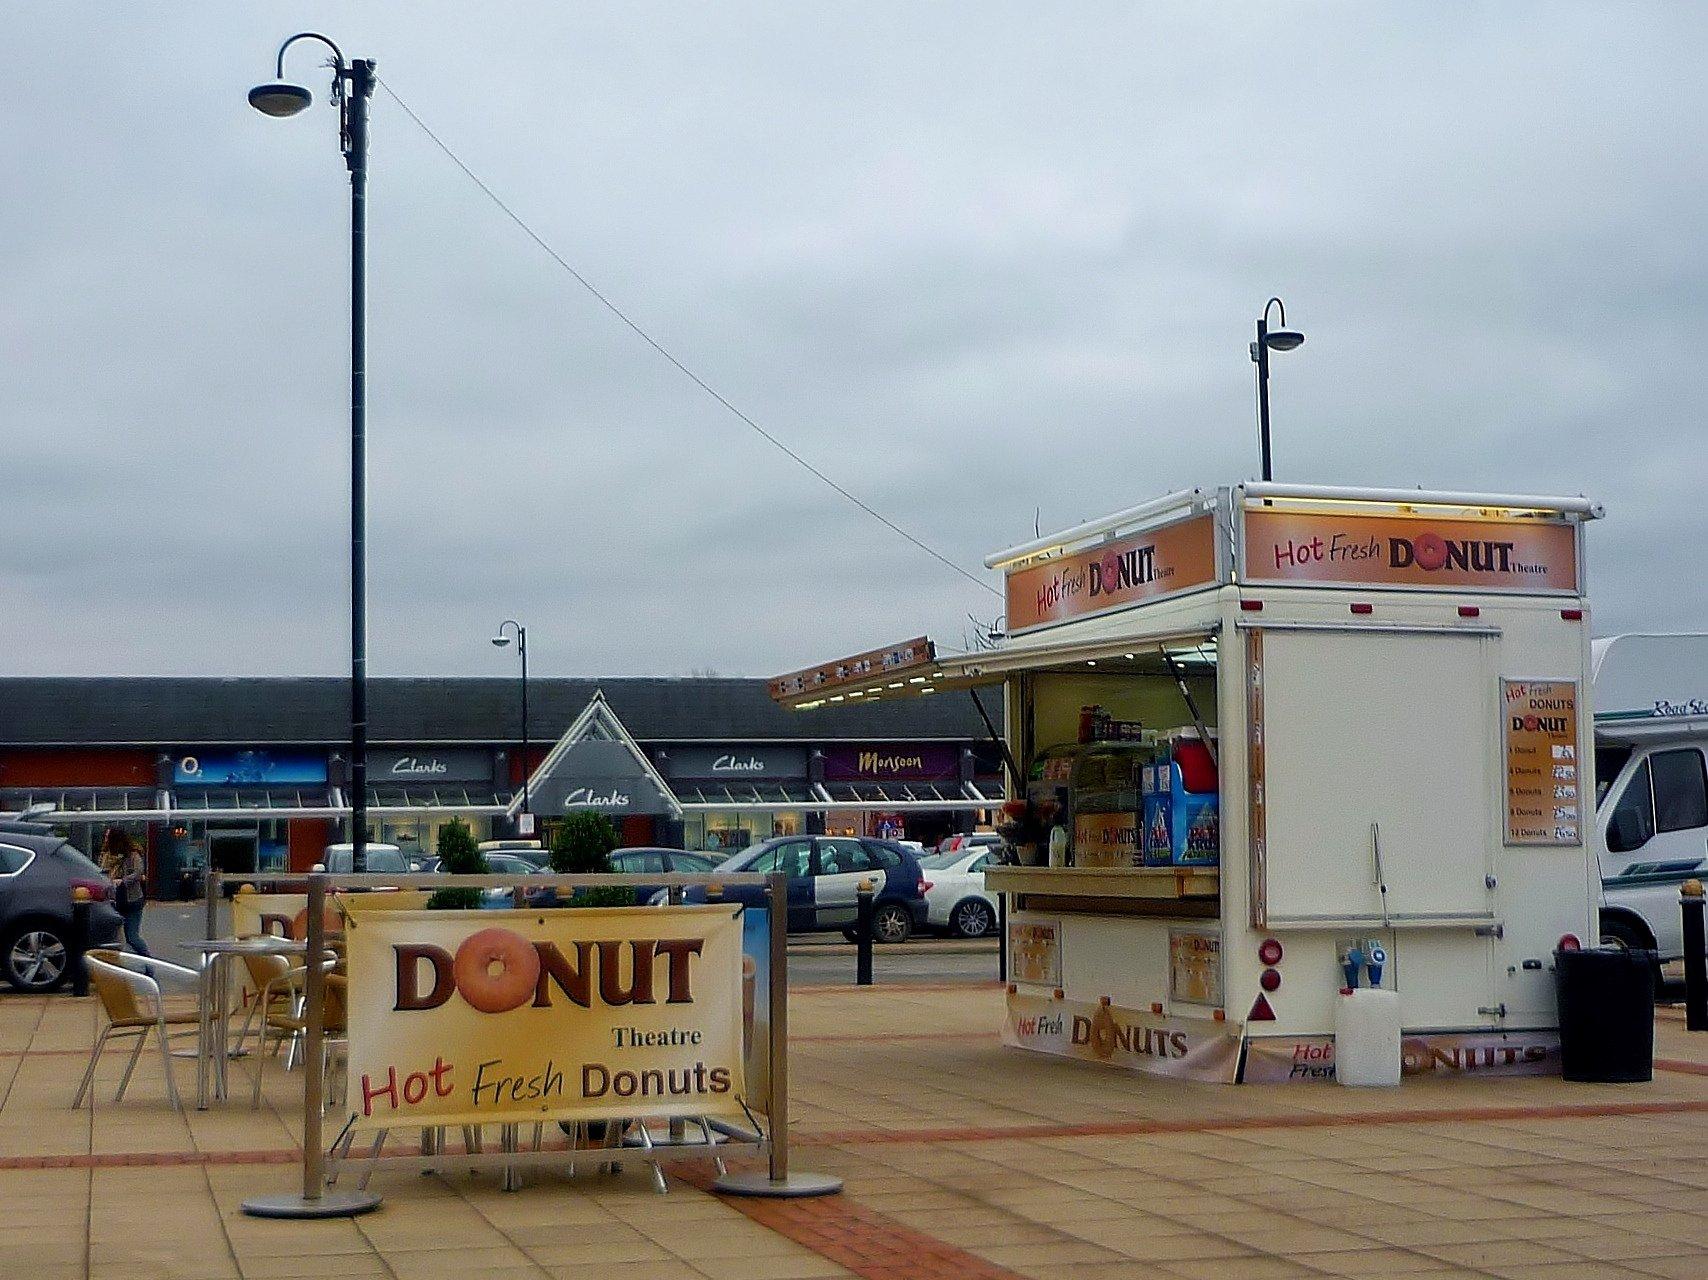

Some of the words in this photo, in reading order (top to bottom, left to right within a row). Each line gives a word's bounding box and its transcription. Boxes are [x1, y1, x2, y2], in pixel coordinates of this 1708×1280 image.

[1274, 536, 1324, 570] Hot
[1330, 532, 1381, 563] Fresh
[1388, 532, 1514, 573] DONUT
[1036, 573, 1060, 616] Hot
[1060, 564, 1086, 600] Fresh
[1089, 544, 1155, 597] DONUT
[1505, 684, 1526, 703] Hot
[1529, 698, 1575, 710] DONUTS
[1512, 714, 1568, 732] DONUT
[181, 756, 203, 778] O2
[391, 756, 448, 775] Clarks
[712, 754, 765, 772] Clarks
[858, 751, 923, 774] Monsoon
[563, 788, 630, 808] Clarks
[392, 927, 705, 1014] DONUT
[1018, 1015, 1036, 1037] Hot
[1036, 1012, 1063, 1037] Fresh
[612, 1026, 702, 1048] Theatre
[1292, 1044, 1334, 1061] Hot
[361, 1057, 455, 1116] Hot
[471, 1060, 564, 1107] Fresh
[581, 1061, 732, 1099] Donuts
